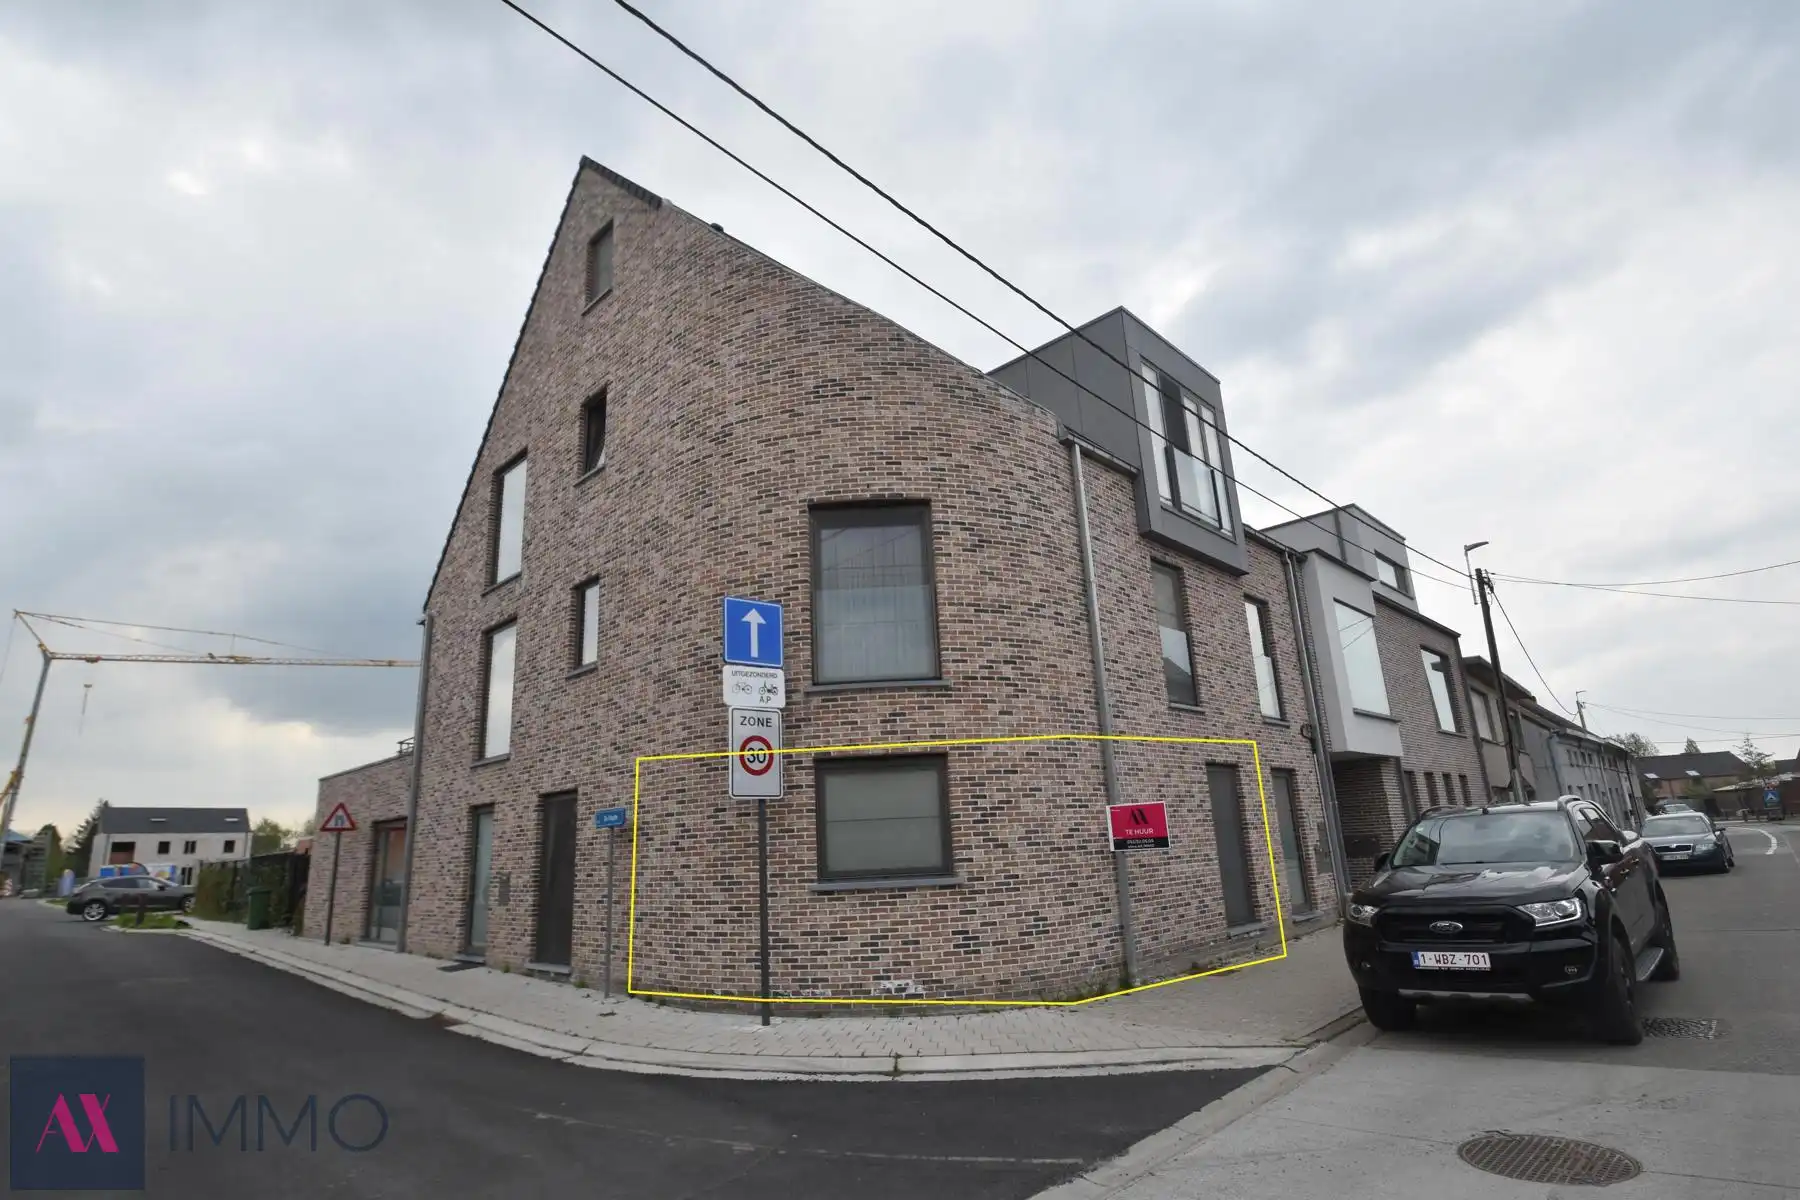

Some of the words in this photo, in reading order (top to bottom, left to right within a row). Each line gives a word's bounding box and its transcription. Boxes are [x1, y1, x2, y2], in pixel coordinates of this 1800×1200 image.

[731, 670, 778, 679] UITGEZONDERD
[740, 716, 773, 728] ZONE
[746, 747, 767, 764] 30
[1421, 953, 1488, 966] 1-WBZ-701
